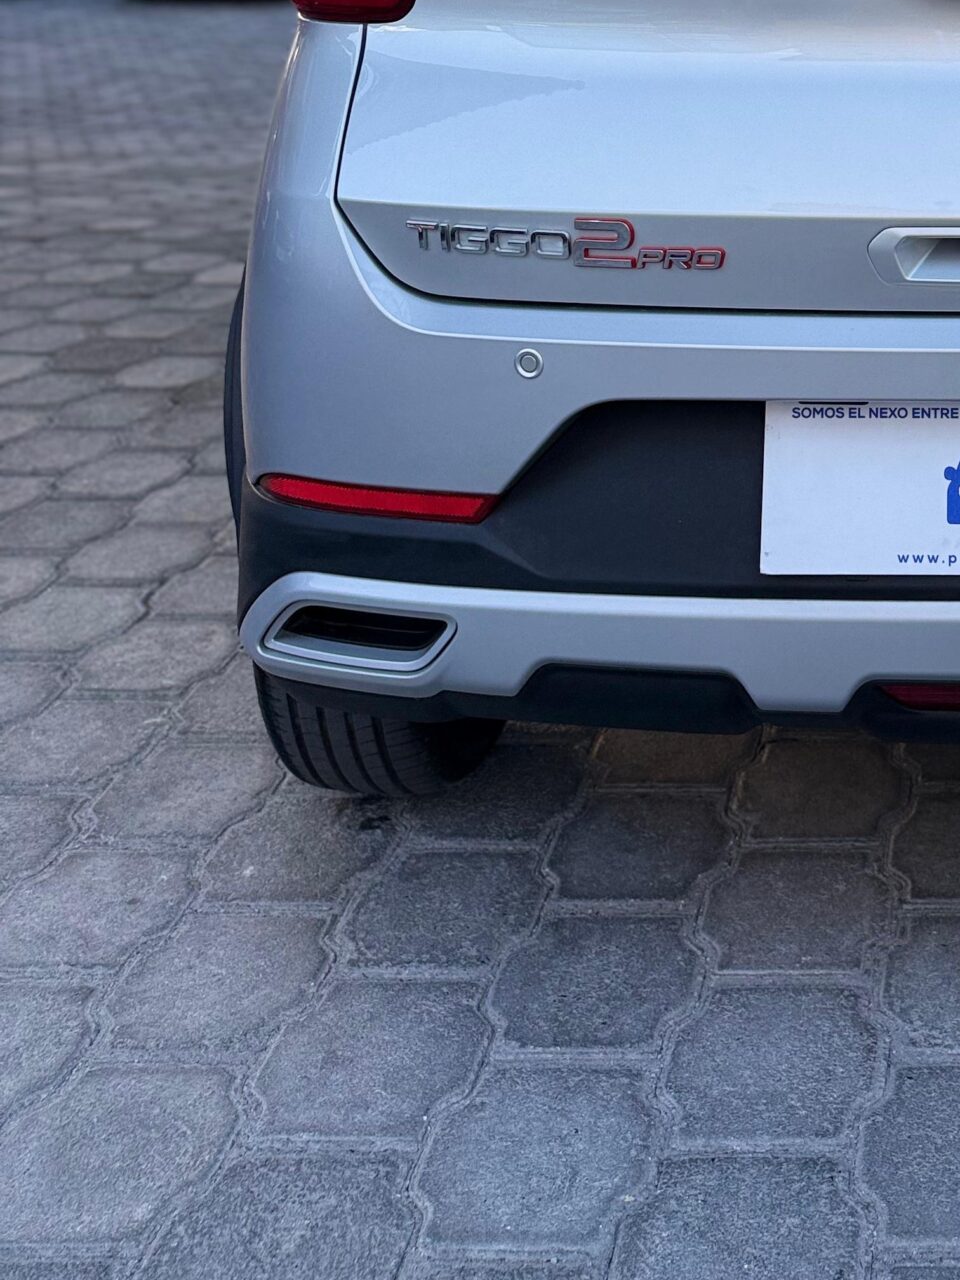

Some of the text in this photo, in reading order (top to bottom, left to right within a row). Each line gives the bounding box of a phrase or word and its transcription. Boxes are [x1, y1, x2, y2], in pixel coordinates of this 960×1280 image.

[791, 406, 845, 419] SOMOS
[848, 407, 866, 419] EL
[868, 407, 909, 419] NEXO
[911, 407, 960, 420] ENTRE
